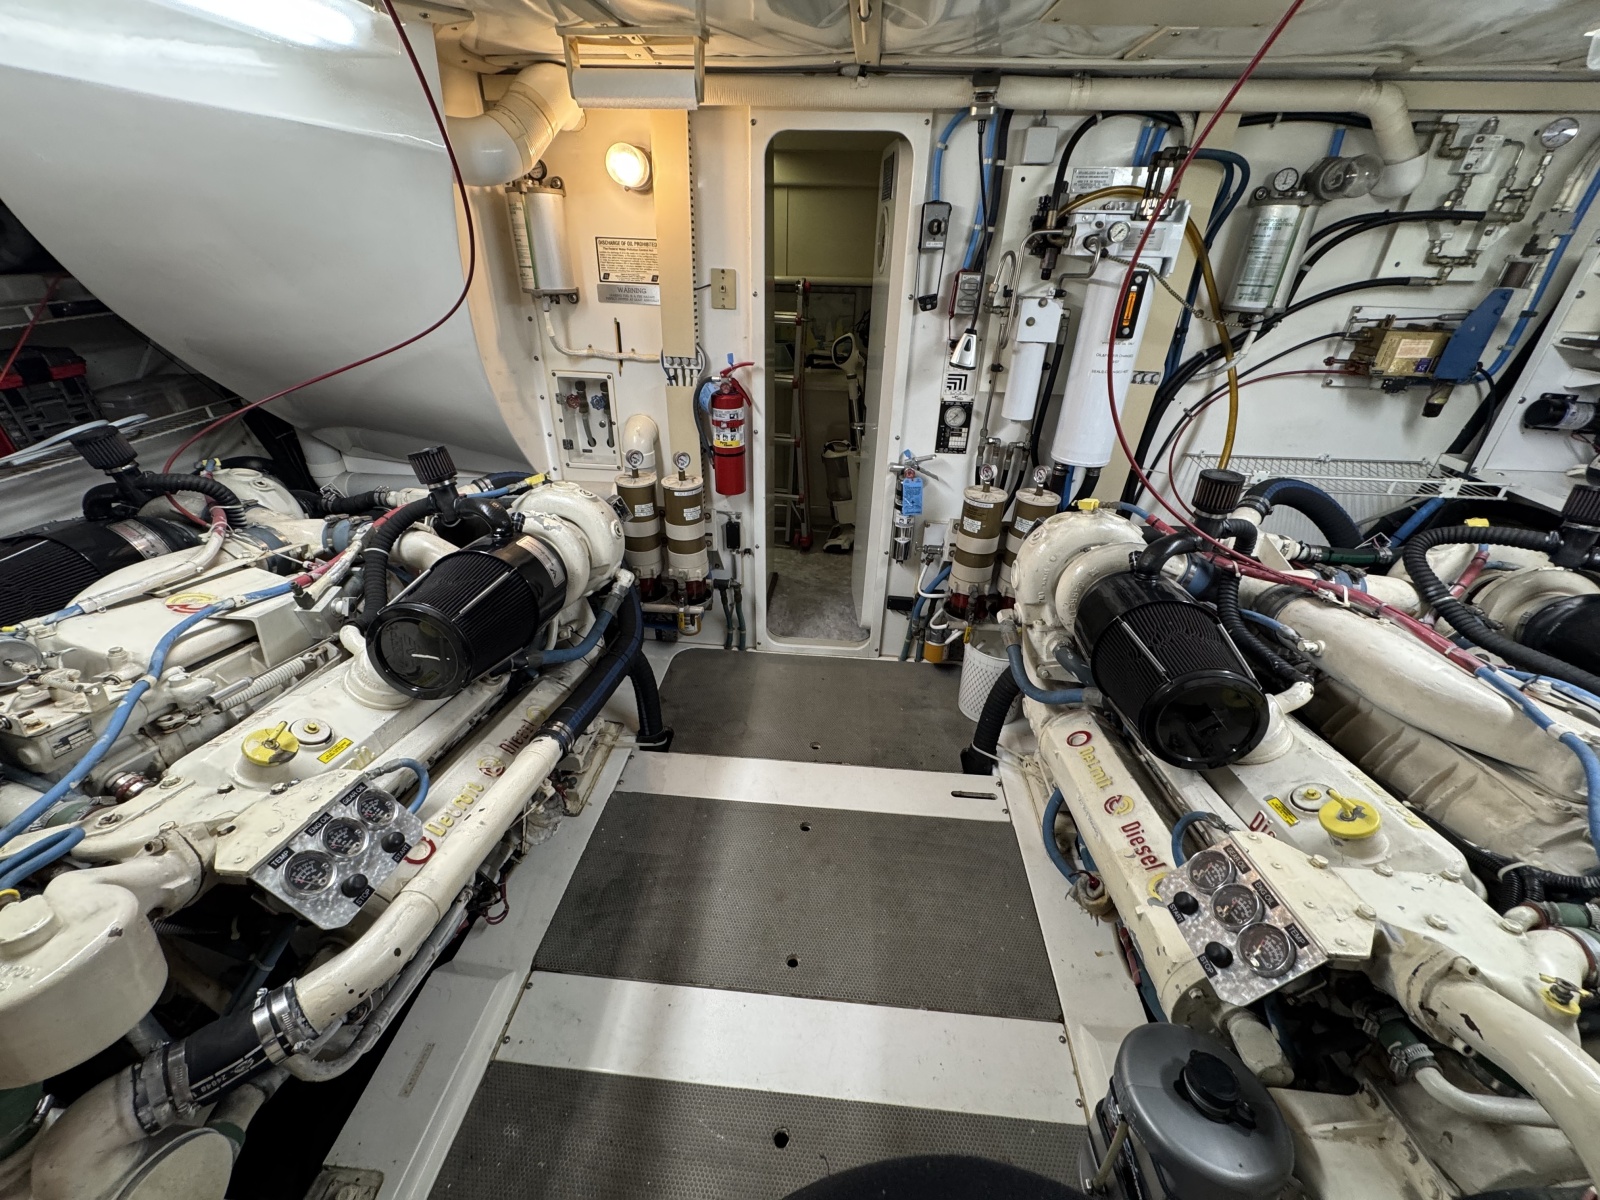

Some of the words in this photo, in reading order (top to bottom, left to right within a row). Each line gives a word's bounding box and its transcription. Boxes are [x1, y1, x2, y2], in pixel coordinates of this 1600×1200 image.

[499, 719, 536, 755] Diesel
[342, 791, 356, 804] GEAR
[356, 784, 366, 794] OIL
[308, 822, 321, 835] ENG
[319, 814, 332, 825] OIL
[394, 844, 410, 862] START
[1120, 820, 1167, 871] Diesel
[270, 850, 289, 866] TEMP
[1227, 848, 1241, 863] GEAR
[1237, 860, 1248, 871] OIL
[355, 888, 371, 905] STOP
[1255, 882, 1268, 896] ENG
[1264, 893, 1275, 906] OIL
[1169, 904, 1184, 922] START
[1288, 926, 1306, 944] TEMP
[1200, 955, 1214, 974] STOP
